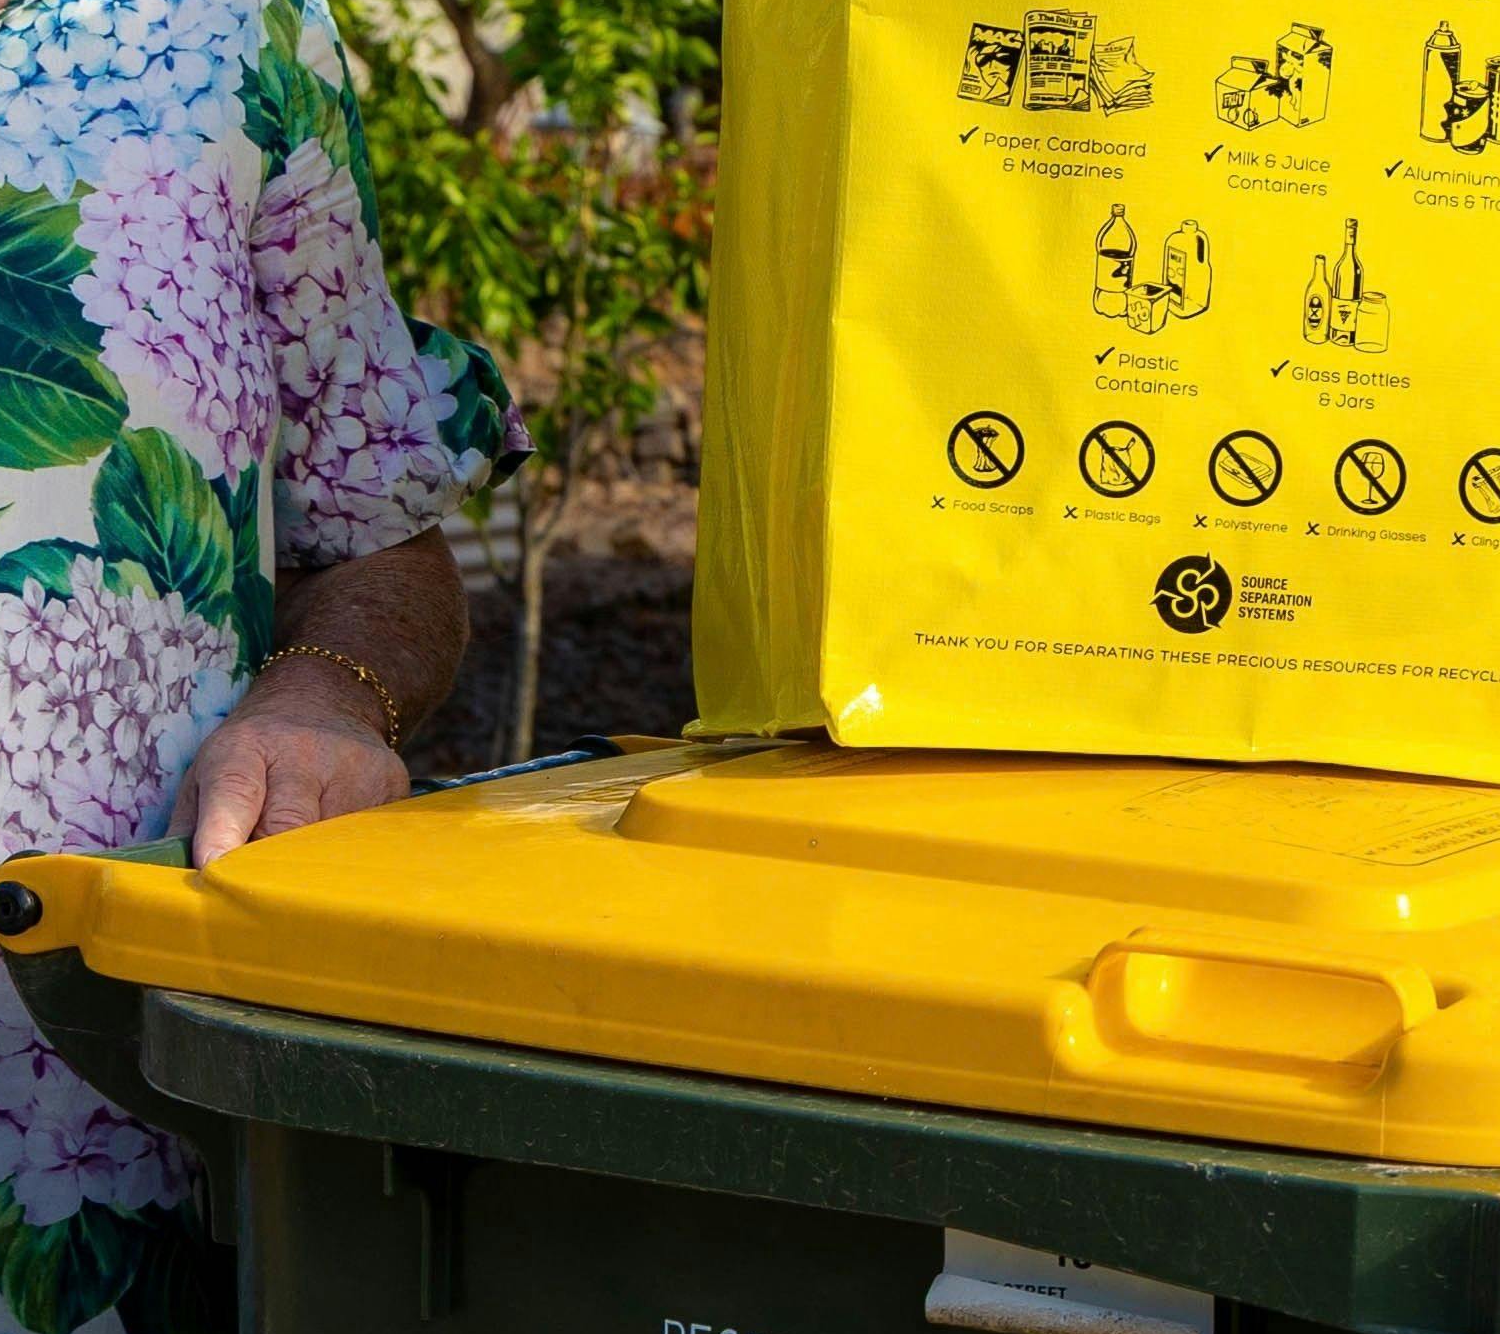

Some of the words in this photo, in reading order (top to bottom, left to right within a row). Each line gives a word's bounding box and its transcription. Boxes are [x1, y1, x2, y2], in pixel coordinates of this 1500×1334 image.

[984, 132, 1041, 152] Paper,
[1047, 136, 1146, 157] Cardboard
[1003, 158, 1015, 172] &
[1021, 159, 1124, 180] Magazines
[1228, 151, 1259, 167] Milk
[1265, 154, 1276, 168] &
[1281, 155, 1331, 173] Juice
[1228, 174, 1328, 197] Containers
[1414, 190, 1459, 208] Cans
[1464, 195, 1475, 209] &
[1118, 353, 1179, 371] Plastic
[1095, 375, 1199, 397] Containers
[1292, 366, 1341, 384] Glass
[1347, 370, 1411, 389] Bottles
[1319, 392, 1331, 407] &
[1336, 393, 1375, 410] Jars
[953, 499, 985, 513] Food
[989, 502, 1034, 516] Scraps
[1085, 509, 1125, 523] Plastic
[1129, 512, 1161, 526] Bags
[1215, 518, 1288, 534] Polystyrene
[1327, 525, 1376, 542] Drinking
[1379, 529, 1427, 543] Glasses
[1471, 535, 1500, 551] Cling
[1241, 575, 1288, 591] SOURCE
[1239, 591, 1313, 608] SEPARATION
[1238, 605, 1295, 622] SYSTEMS
[914, 632, 969, 649] THANK
[974, 636, 1009, 651] YOU
[1014, 640, 1047, 653] FOR
[1052, 642, 1155, 662] SEPARATING
[1160, 649, 1211, 665] THESE
[1216, 653, 1298, 671] PRECIOUS
[1302, 658, 1397, 676] RESOURCES
[1402, 664, 1434, 678] FOR
